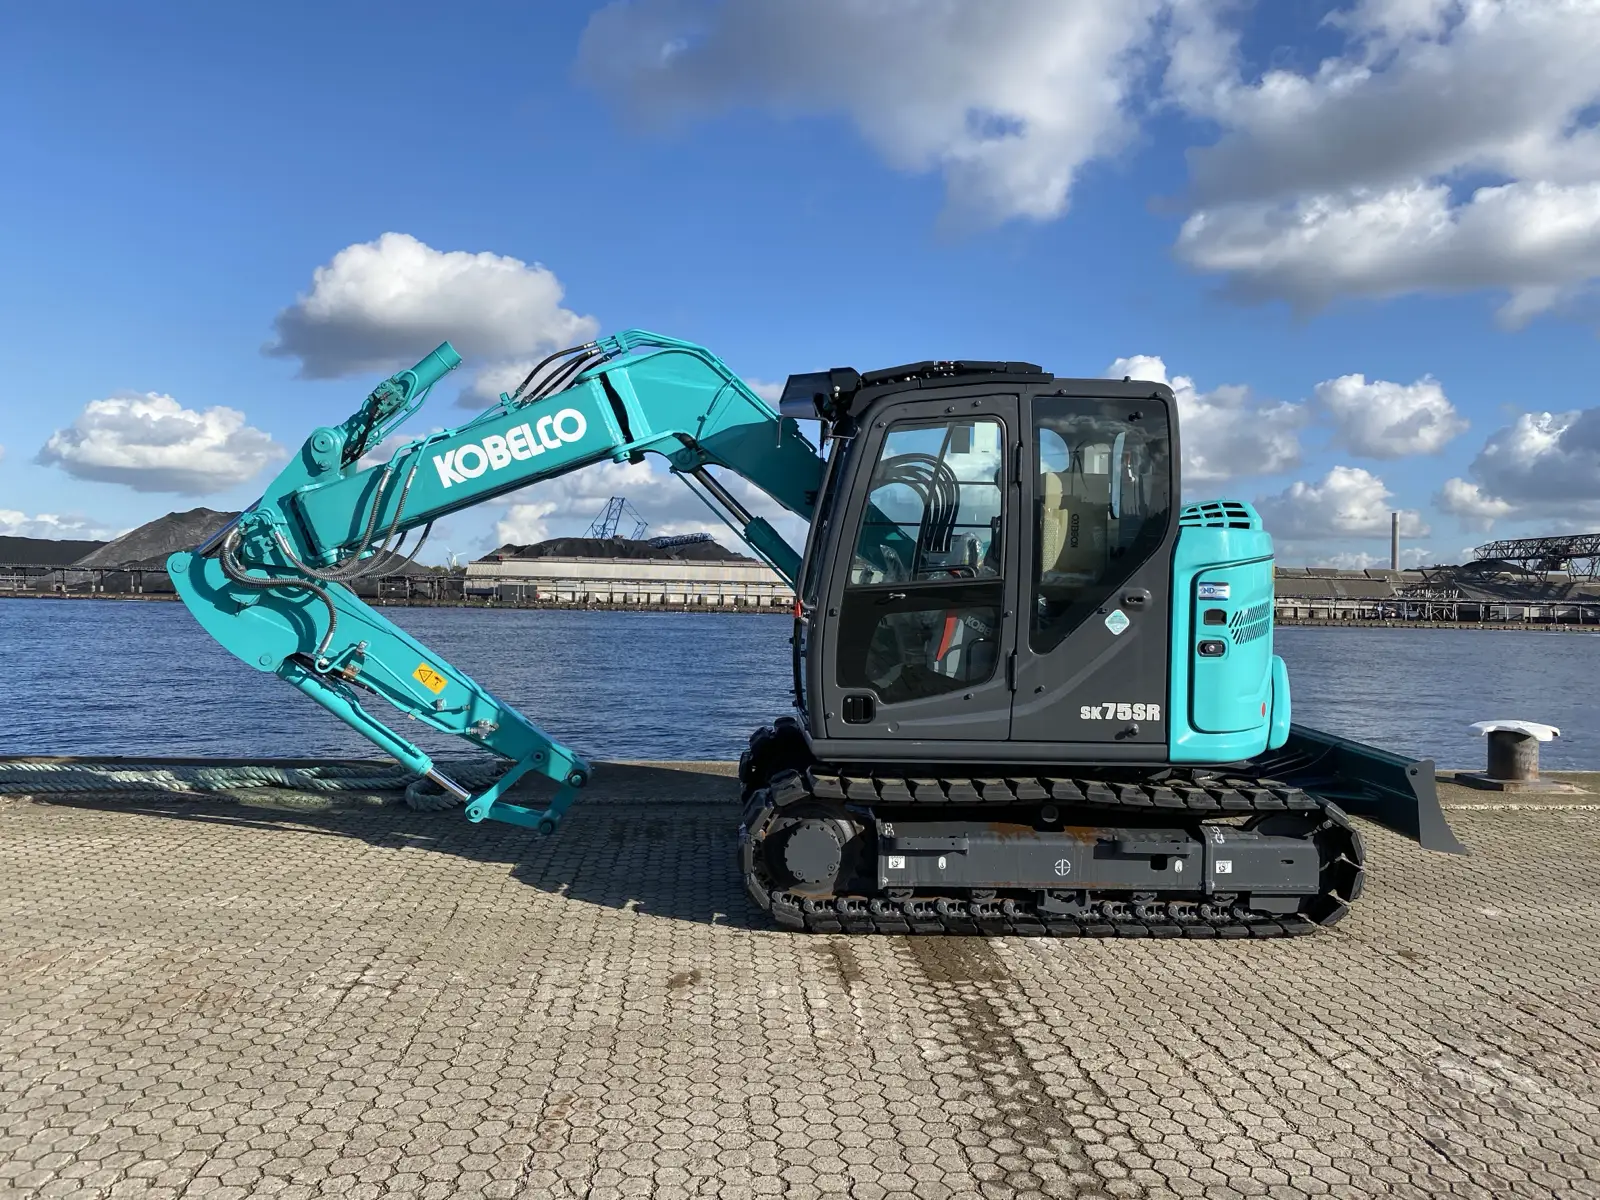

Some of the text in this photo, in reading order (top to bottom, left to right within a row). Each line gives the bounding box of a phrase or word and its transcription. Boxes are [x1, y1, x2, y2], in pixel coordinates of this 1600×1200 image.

[432, 408, 587, 489] KOBELCO
[1071, 513, 1080, 548] KOBELCO
[1080, 702, 1161, 721] SK75SR
